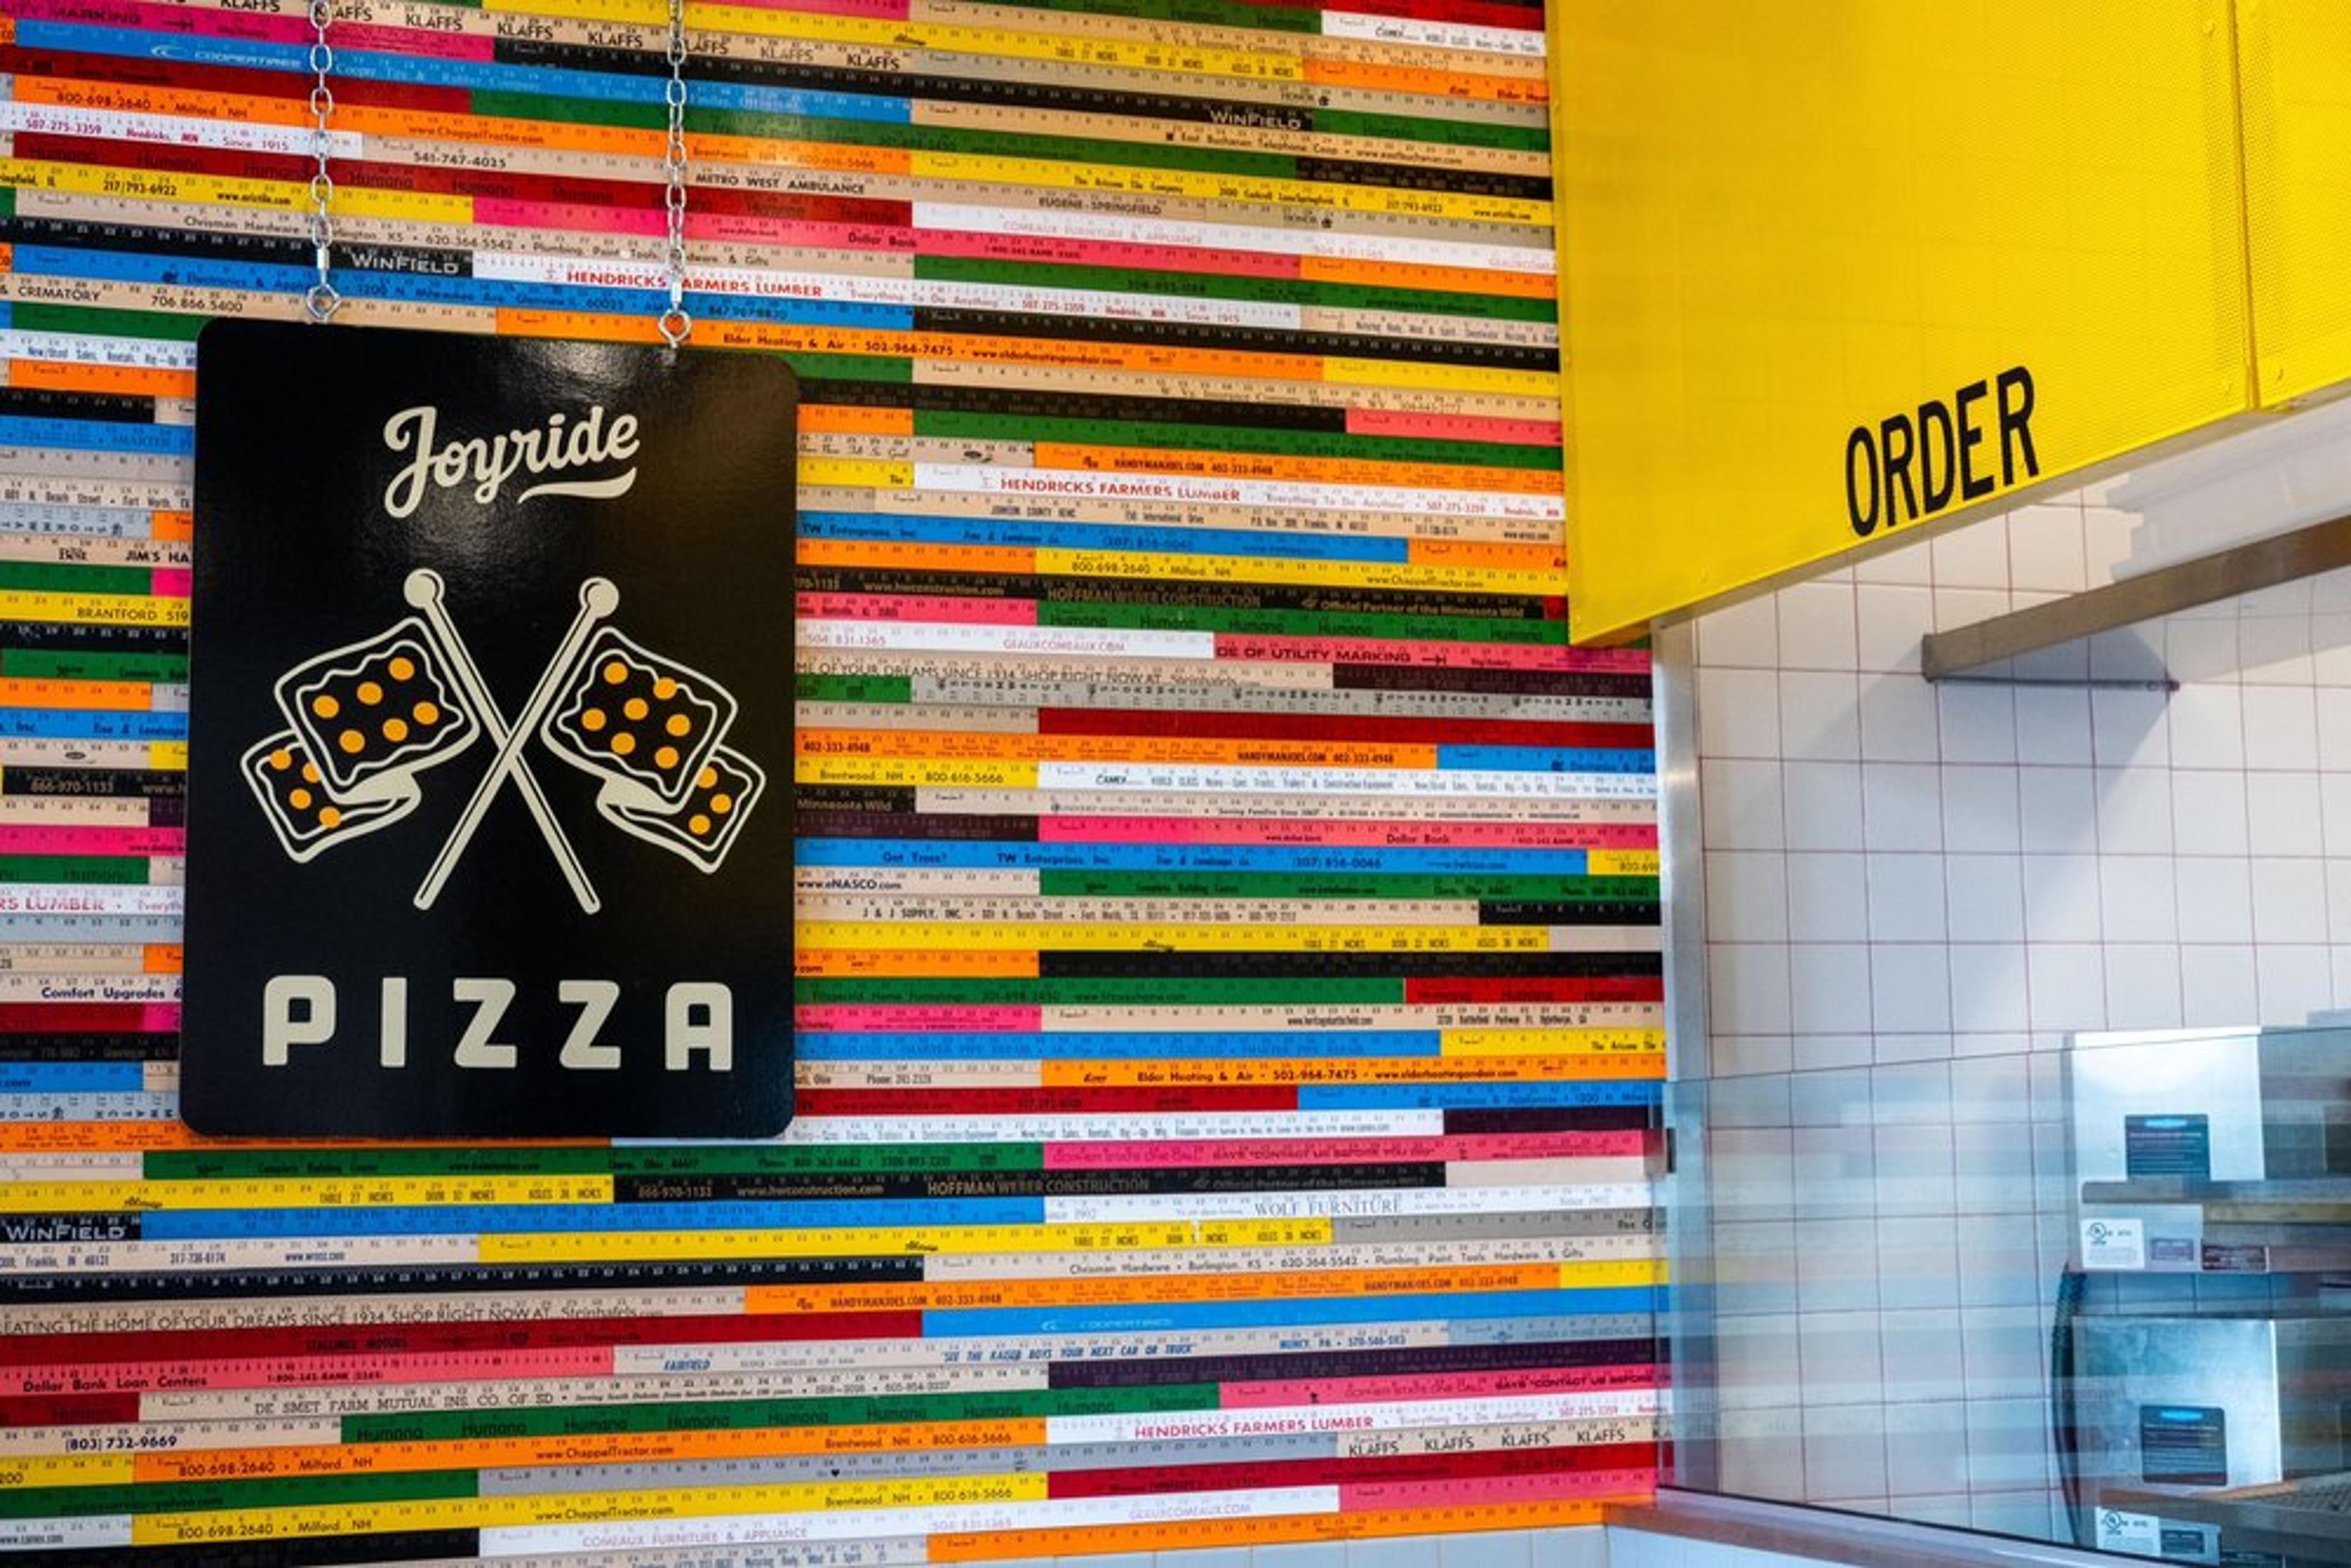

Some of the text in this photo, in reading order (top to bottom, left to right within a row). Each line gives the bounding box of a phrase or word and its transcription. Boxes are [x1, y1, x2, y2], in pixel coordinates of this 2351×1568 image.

[405, 12, 463, 31] KLAFFS
[497, 21, 553, 39] KLAFFS
[588, 29, 644, 48] KLAFFS
[846, 53, 901, 71] KLAFFS
[176, 102, 217, 116] Milford
[223, 137, 252, 149] Since
[262, 140, 288, 151] 1915
[695, 174, 864, 195] METRO WEST AMBULANCE
[185, 216, 299, 234] Chrisman Hardware
[847, 231, 883, 246] Dollar
[567, 271, 821, 296] HENDRICKS ARMERS LUMBER
[18, 288, 100, 301] CREMATORY
[724, 334, 752, 345] Elder
[757, 336, 803, 350] Heating
[1846, 366, 2039, 537] ORDER
[383, 406, 640, 519] Joyride
[1001, 478, 1172, 498] HENDRICKS FARMERS
[126, 552, 160, 562] JIM'S
[1048, 589, 1115, 602] HOFFMAN
[77, 608, 157, 621] BRANTFORD
[1244, 648, 1411, 662] OF UTILITY MARKING
[820, 770, 876, 782] Brentwood
[865, 801, 891, 812] Wild
[1387, 835, 1449, 845] Dollar Bank
[42, 988, 165, 999] Comfort Upgrades
[263, 975, 733, 1071] PIZZA
[1138, 1072, 1163, 1082] Elder
[1170, 1071, 1214, 1084] Heating
[1220, 1072, 1228, 1081] &
[1236, 1071, 1254, 1081] Air
[1273, 1070, 1357, 1081] 502-964-7475
[928, 1180, 995, 1196] HOFFMAN
[1255, 1199, 1401, 1216] WOLF FURNITURE
[1070, 1263, 1116, 1275] Chrisman
[1122, 1261, 1170, 1274] Hardware
[69, 1318, 99, 1331] THE
[105, 1316, 152, 1329] HOME
[157, 1315, 180, 1329] OF
[184, 1314, 226, 1328] YOUR
[234, 1313, 296, 1327] DREAMS
[302, 1312, 345, 1324] SINCE
[391, 1308, 433, 1322] SHOP
[437, 1309, 484, 1321] RIGHT
[489, 1308, 531, 1320] NOW
[533, 1308, 550, 1319] AT
[23, 1375, 206, 1392] Dollar Bank Loan Centers
[255, 1402, 276, 1414] DE
[283, 1401, 321, 1412] SMET
[329, 1399, 370, 1411] FARM
[378, 1395, 435, 1409] MUTUAL
[509, 1393, 527, 1404] OF
[536, 1392, 553, 1403] SD
[357, 1418, 628, 1441] Humana Humana
[1134, 1416, 1373, 1438] HENDRICKS FARMERS LUMBER
[65, 1435, 177, 1452] (803) 732-9669
[1349, 1428, 1625, 1456] KLAFFS KLAFFS KLAFFS KLAFFS
[299, 1460, 341, 1470] Milford
[537, 1446, 673, 1459] www.ChappelTractor.com
[825, 1436, 882, 1449] Brentwood
[933, 1433, 1011, 1445] 800-616-5666
[298, 1521, 340, 1532] Milford
[536, 1506, 673, 1520] www.ChappelTractor.com
[825, 1494, 882, 1506] Brentwood
[933, 1489, 1012, 1501] 800-616-5666
[583, 1528, 808, 1547] COMEAUX FURNITURE APPLIANCE
